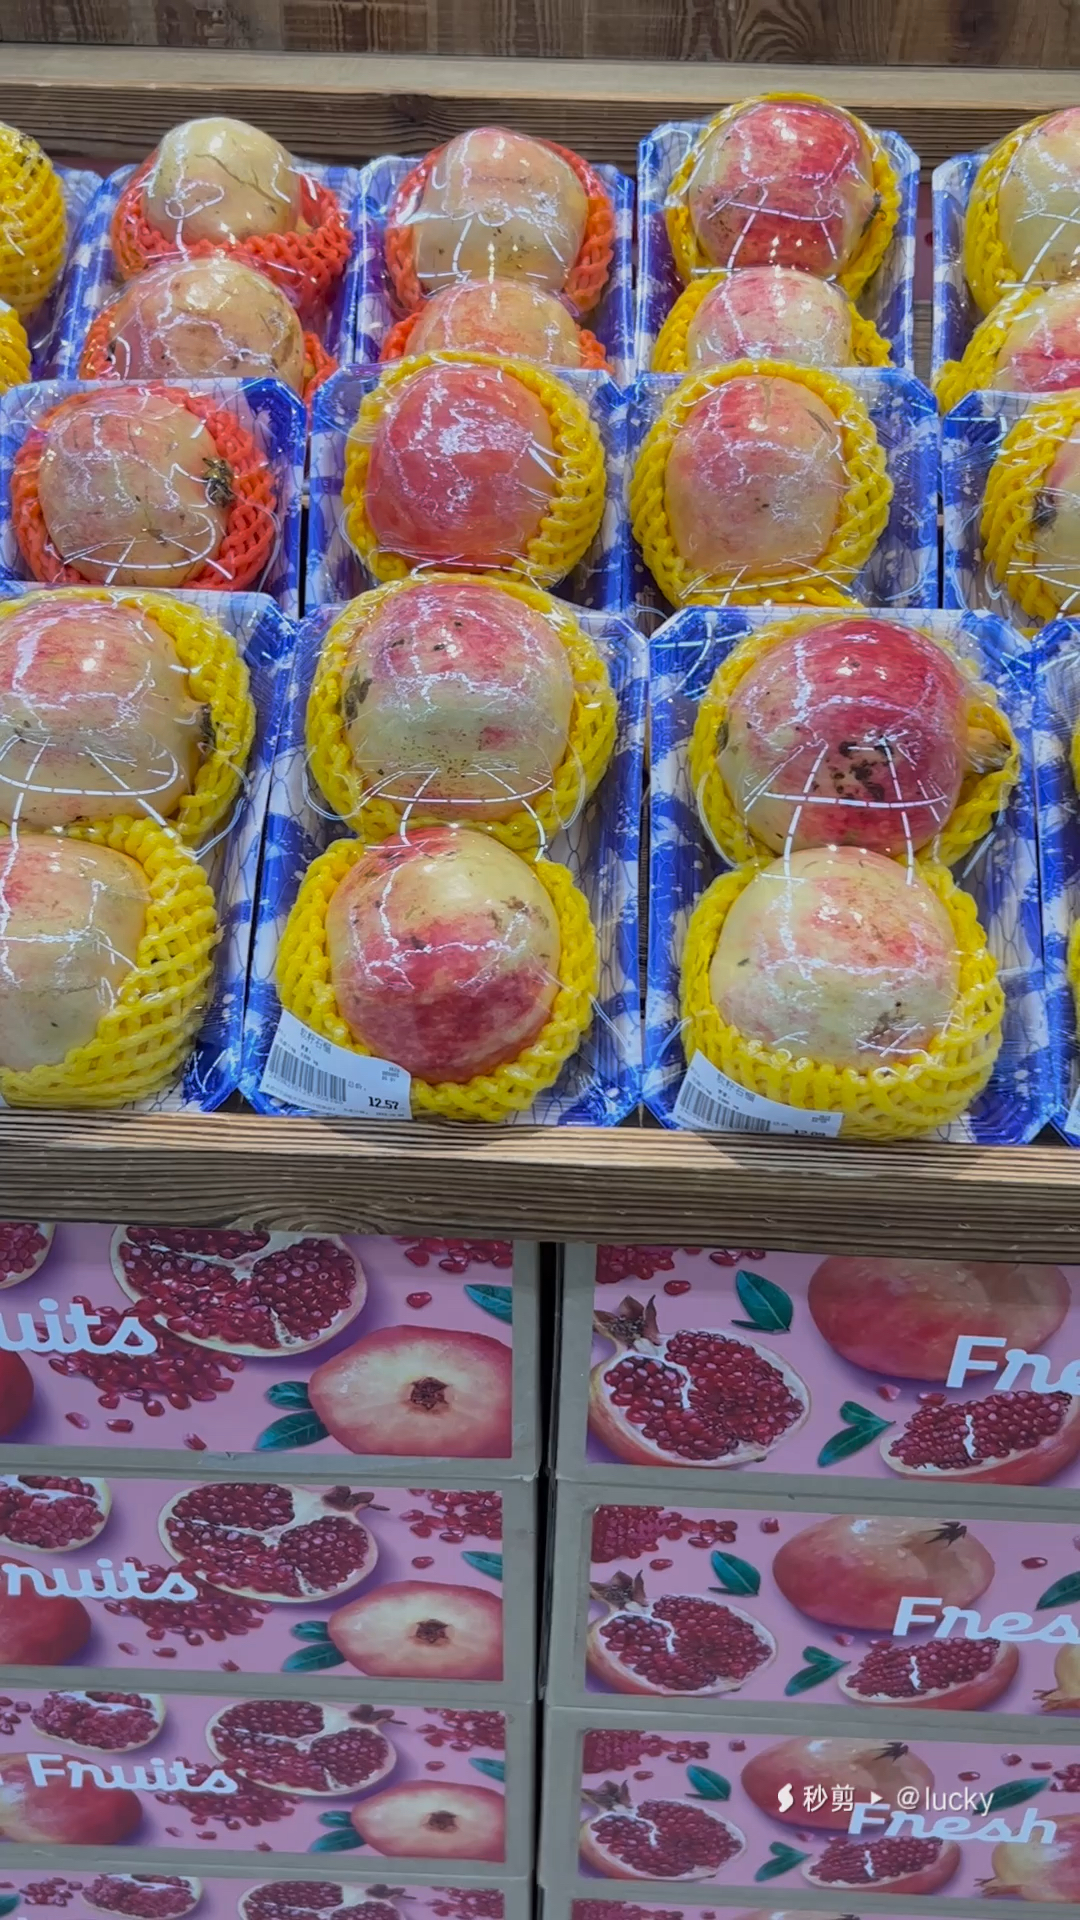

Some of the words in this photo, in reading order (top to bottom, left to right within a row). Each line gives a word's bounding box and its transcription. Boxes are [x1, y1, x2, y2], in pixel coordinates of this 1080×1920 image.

[368, 1096, 399, 1110] 12.57
[26, 1753, 238, 1794] Fruits
[848, 1802, 1057, 1844] Fresh
